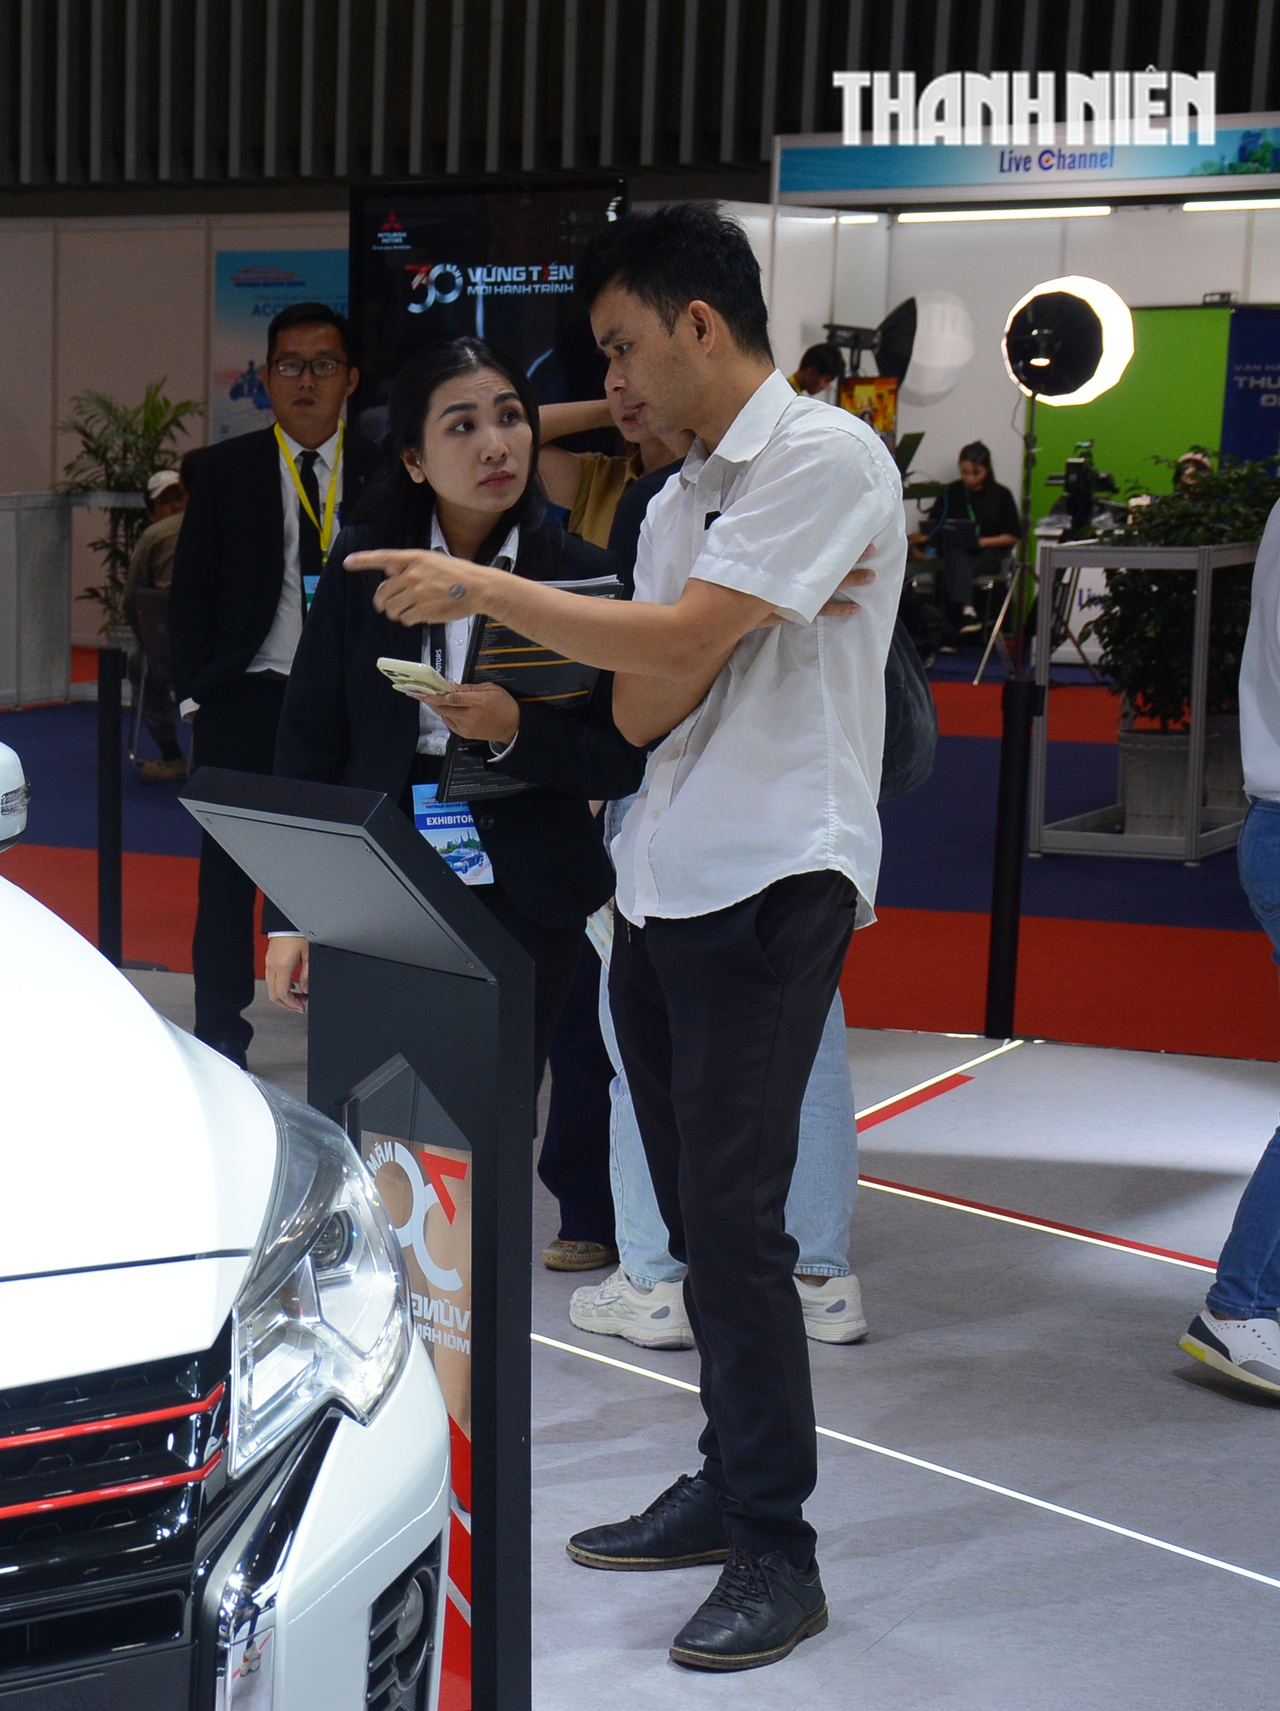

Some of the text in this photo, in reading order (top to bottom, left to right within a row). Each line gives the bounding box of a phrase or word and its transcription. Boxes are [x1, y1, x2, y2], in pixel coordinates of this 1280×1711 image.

[999, 146, 1116, 173] Live Channel
[467, 263, 526, 282] VỮNG
[426, 814, 474, 826] EXHIBITOR
